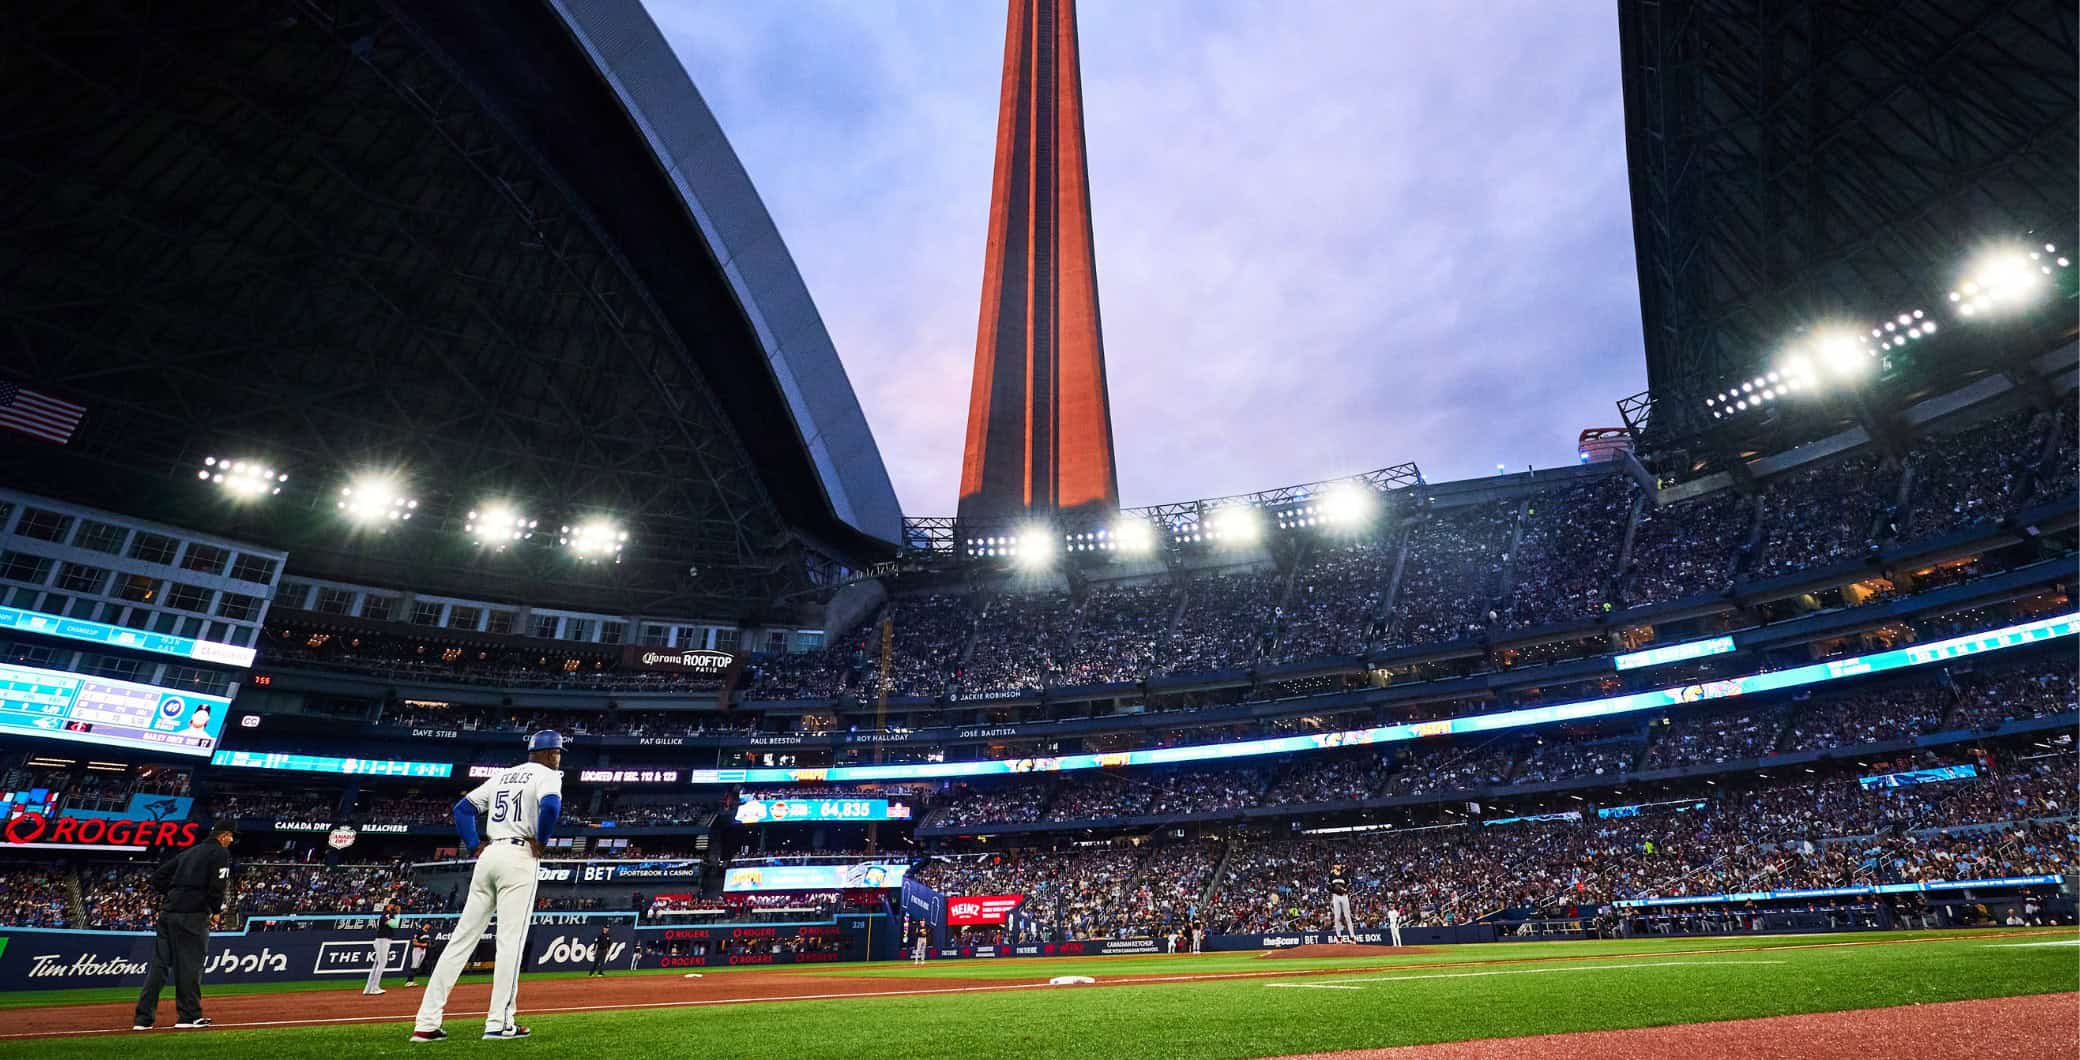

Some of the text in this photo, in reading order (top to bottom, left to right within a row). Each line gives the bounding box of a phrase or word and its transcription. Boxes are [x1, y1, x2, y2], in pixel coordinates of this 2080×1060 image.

[642, 652, 732, 668] Corona ROOFTOP
[960, 692, 983, 700] JACKIE
[985, 691, 1021, 699] ROBINSON
[412, 729, 457, 738] DAVE STIEB
[856, 734, 908, 743] ROY HALLADAY
[769, 737, 801, 745] BEESTON
[492, 790, 524, 823] 51
[52, 817, 199, 847] ROGERS
[274, 821, 332, 831] CANADA DRY
[361, 824, 408, 833] BLEACHERS
[584, 867, 616, 881] BET
[951, 903, 980, 916] HEINZ
[1304, 935, 1319, 944] BET
[1365, 933, 1382, 943] BOX
[203, 947, 287, 973] ubota
[329, 951, 361, 963] THE
[28, 953, 147, 977] Tim Hortons
